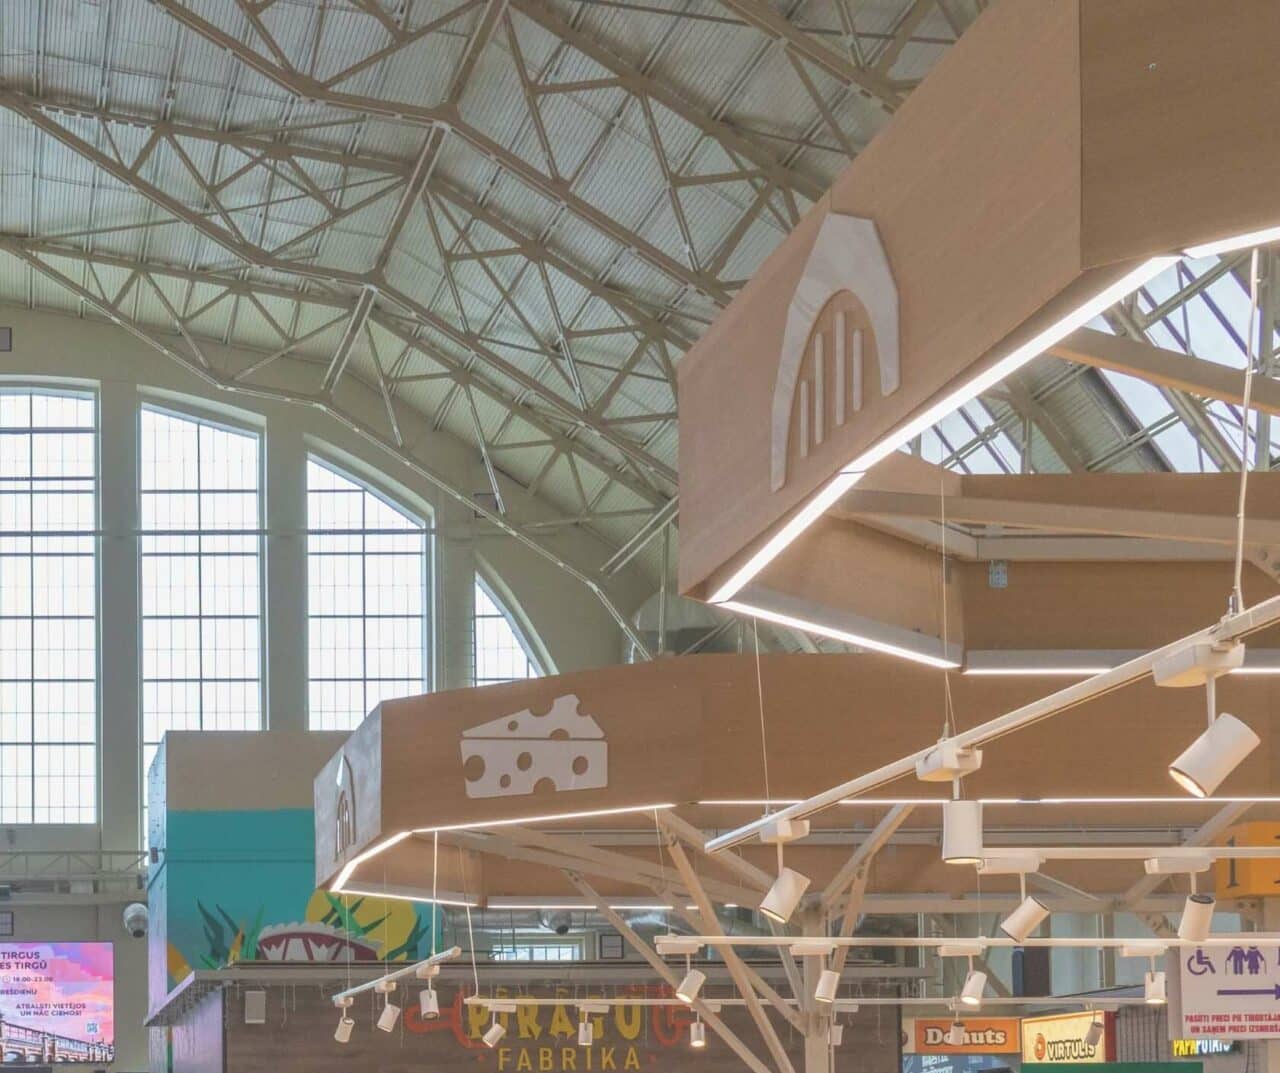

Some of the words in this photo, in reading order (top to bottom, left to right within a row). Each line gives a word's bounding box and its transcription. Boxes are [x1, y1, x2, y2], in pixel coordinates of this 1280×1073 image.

[0, 952, 40, 960] TIRGUS
[14, 959, 48, 970] TIRGŪ
[498, 1047, 641, 1071] FABRIKA
